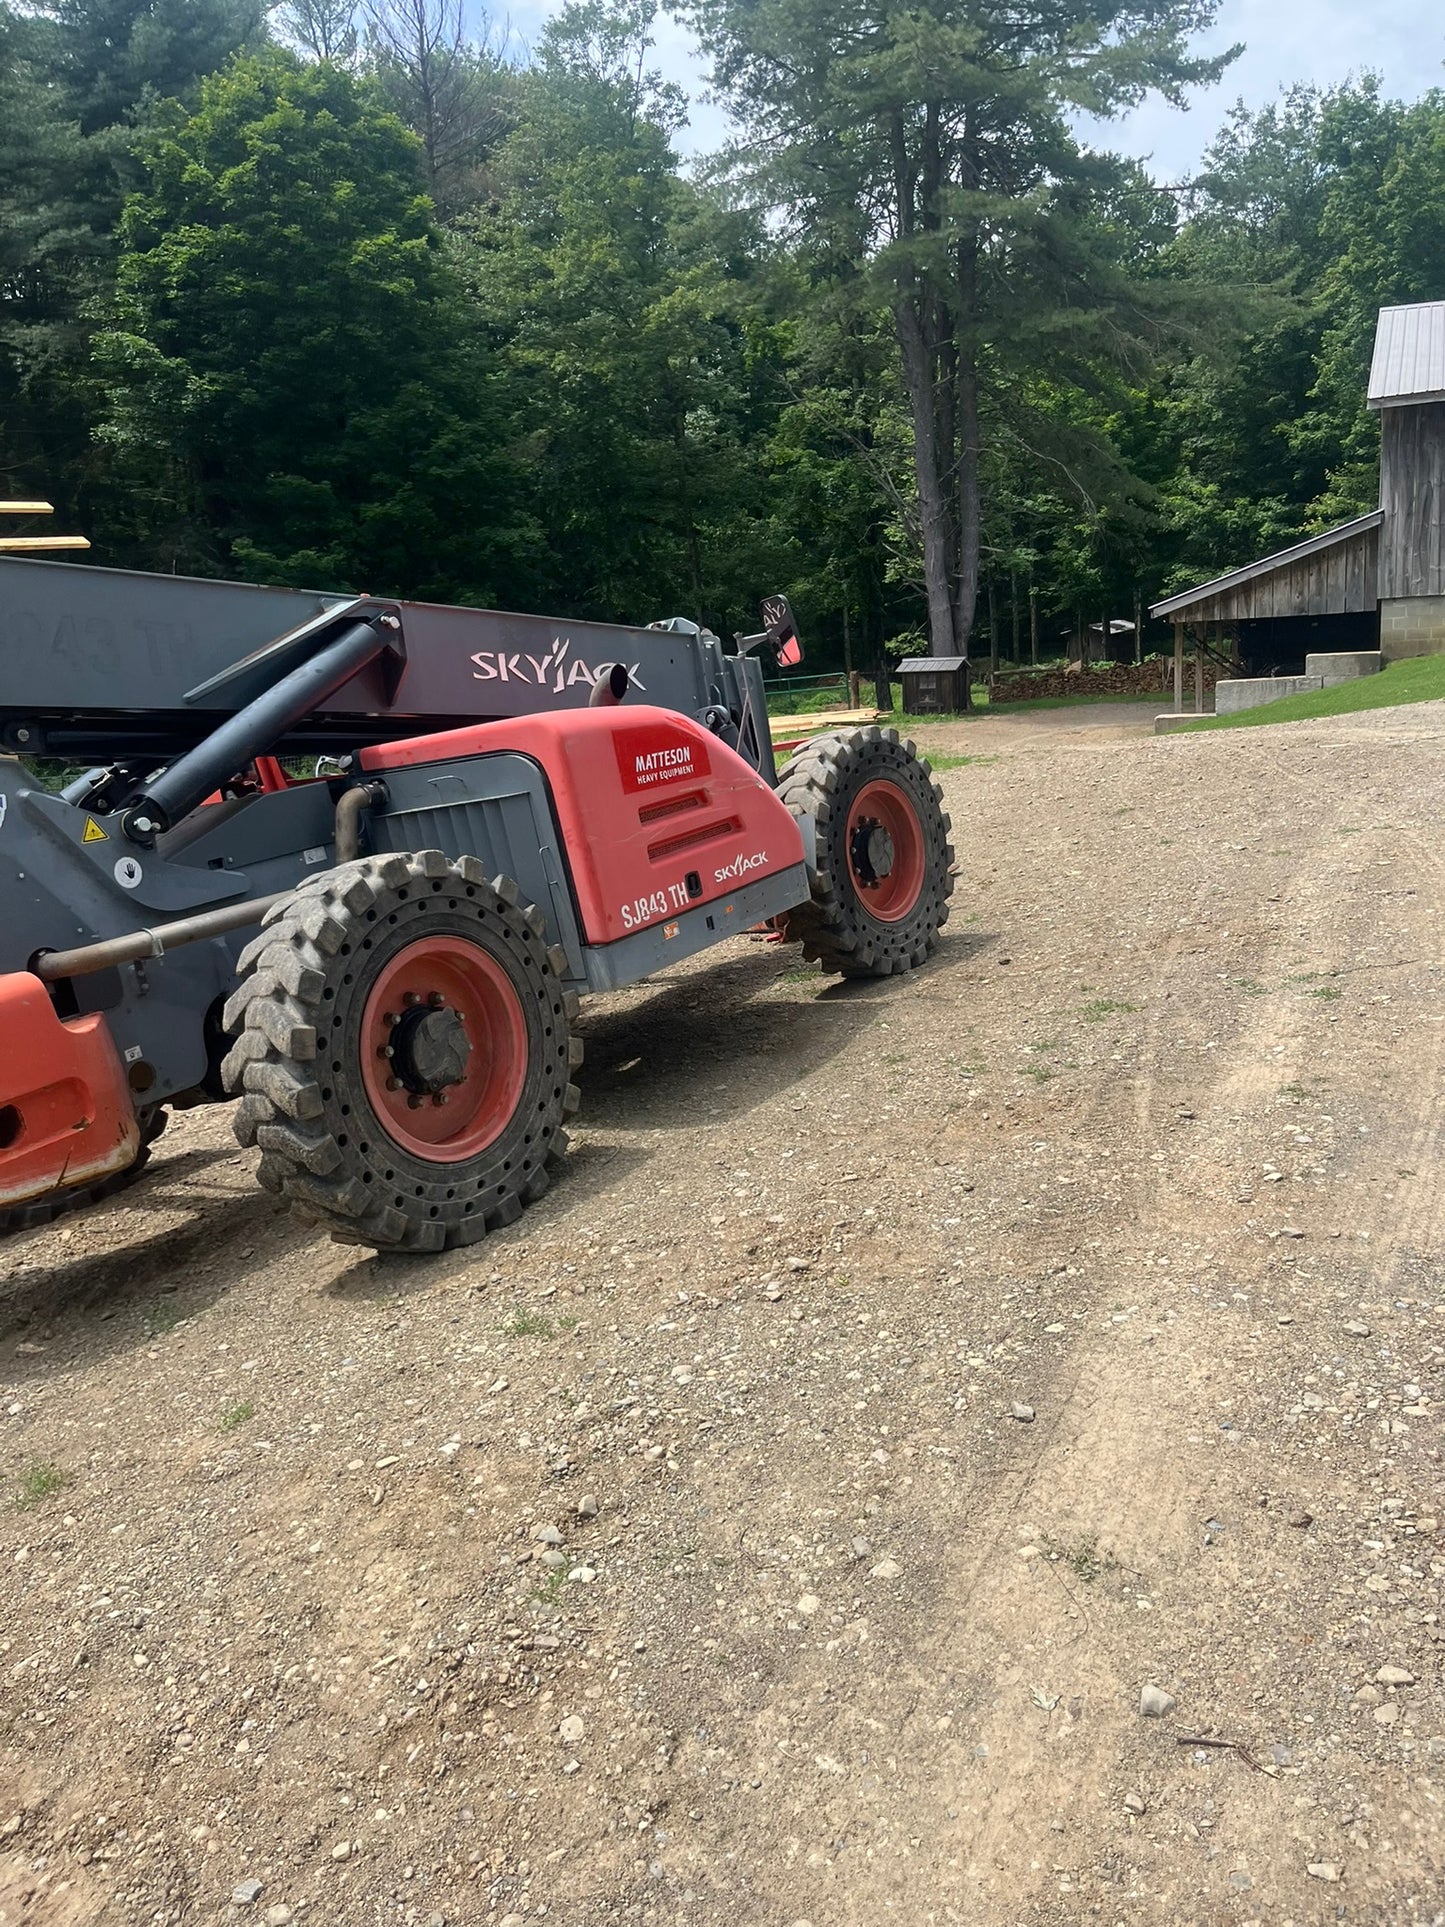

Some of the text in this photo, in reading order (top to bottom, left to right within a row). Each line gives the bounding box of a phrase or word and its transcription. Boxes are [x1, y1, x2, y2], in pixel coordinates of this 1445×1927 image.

[635, 746, 691, 773] MATTESON
[636, 764, 695, 785] HEAVY EQUIPMENT
[714, 851, 769, 883] SKYJACK
[620, 882, 690, 929] SJ843 TH
